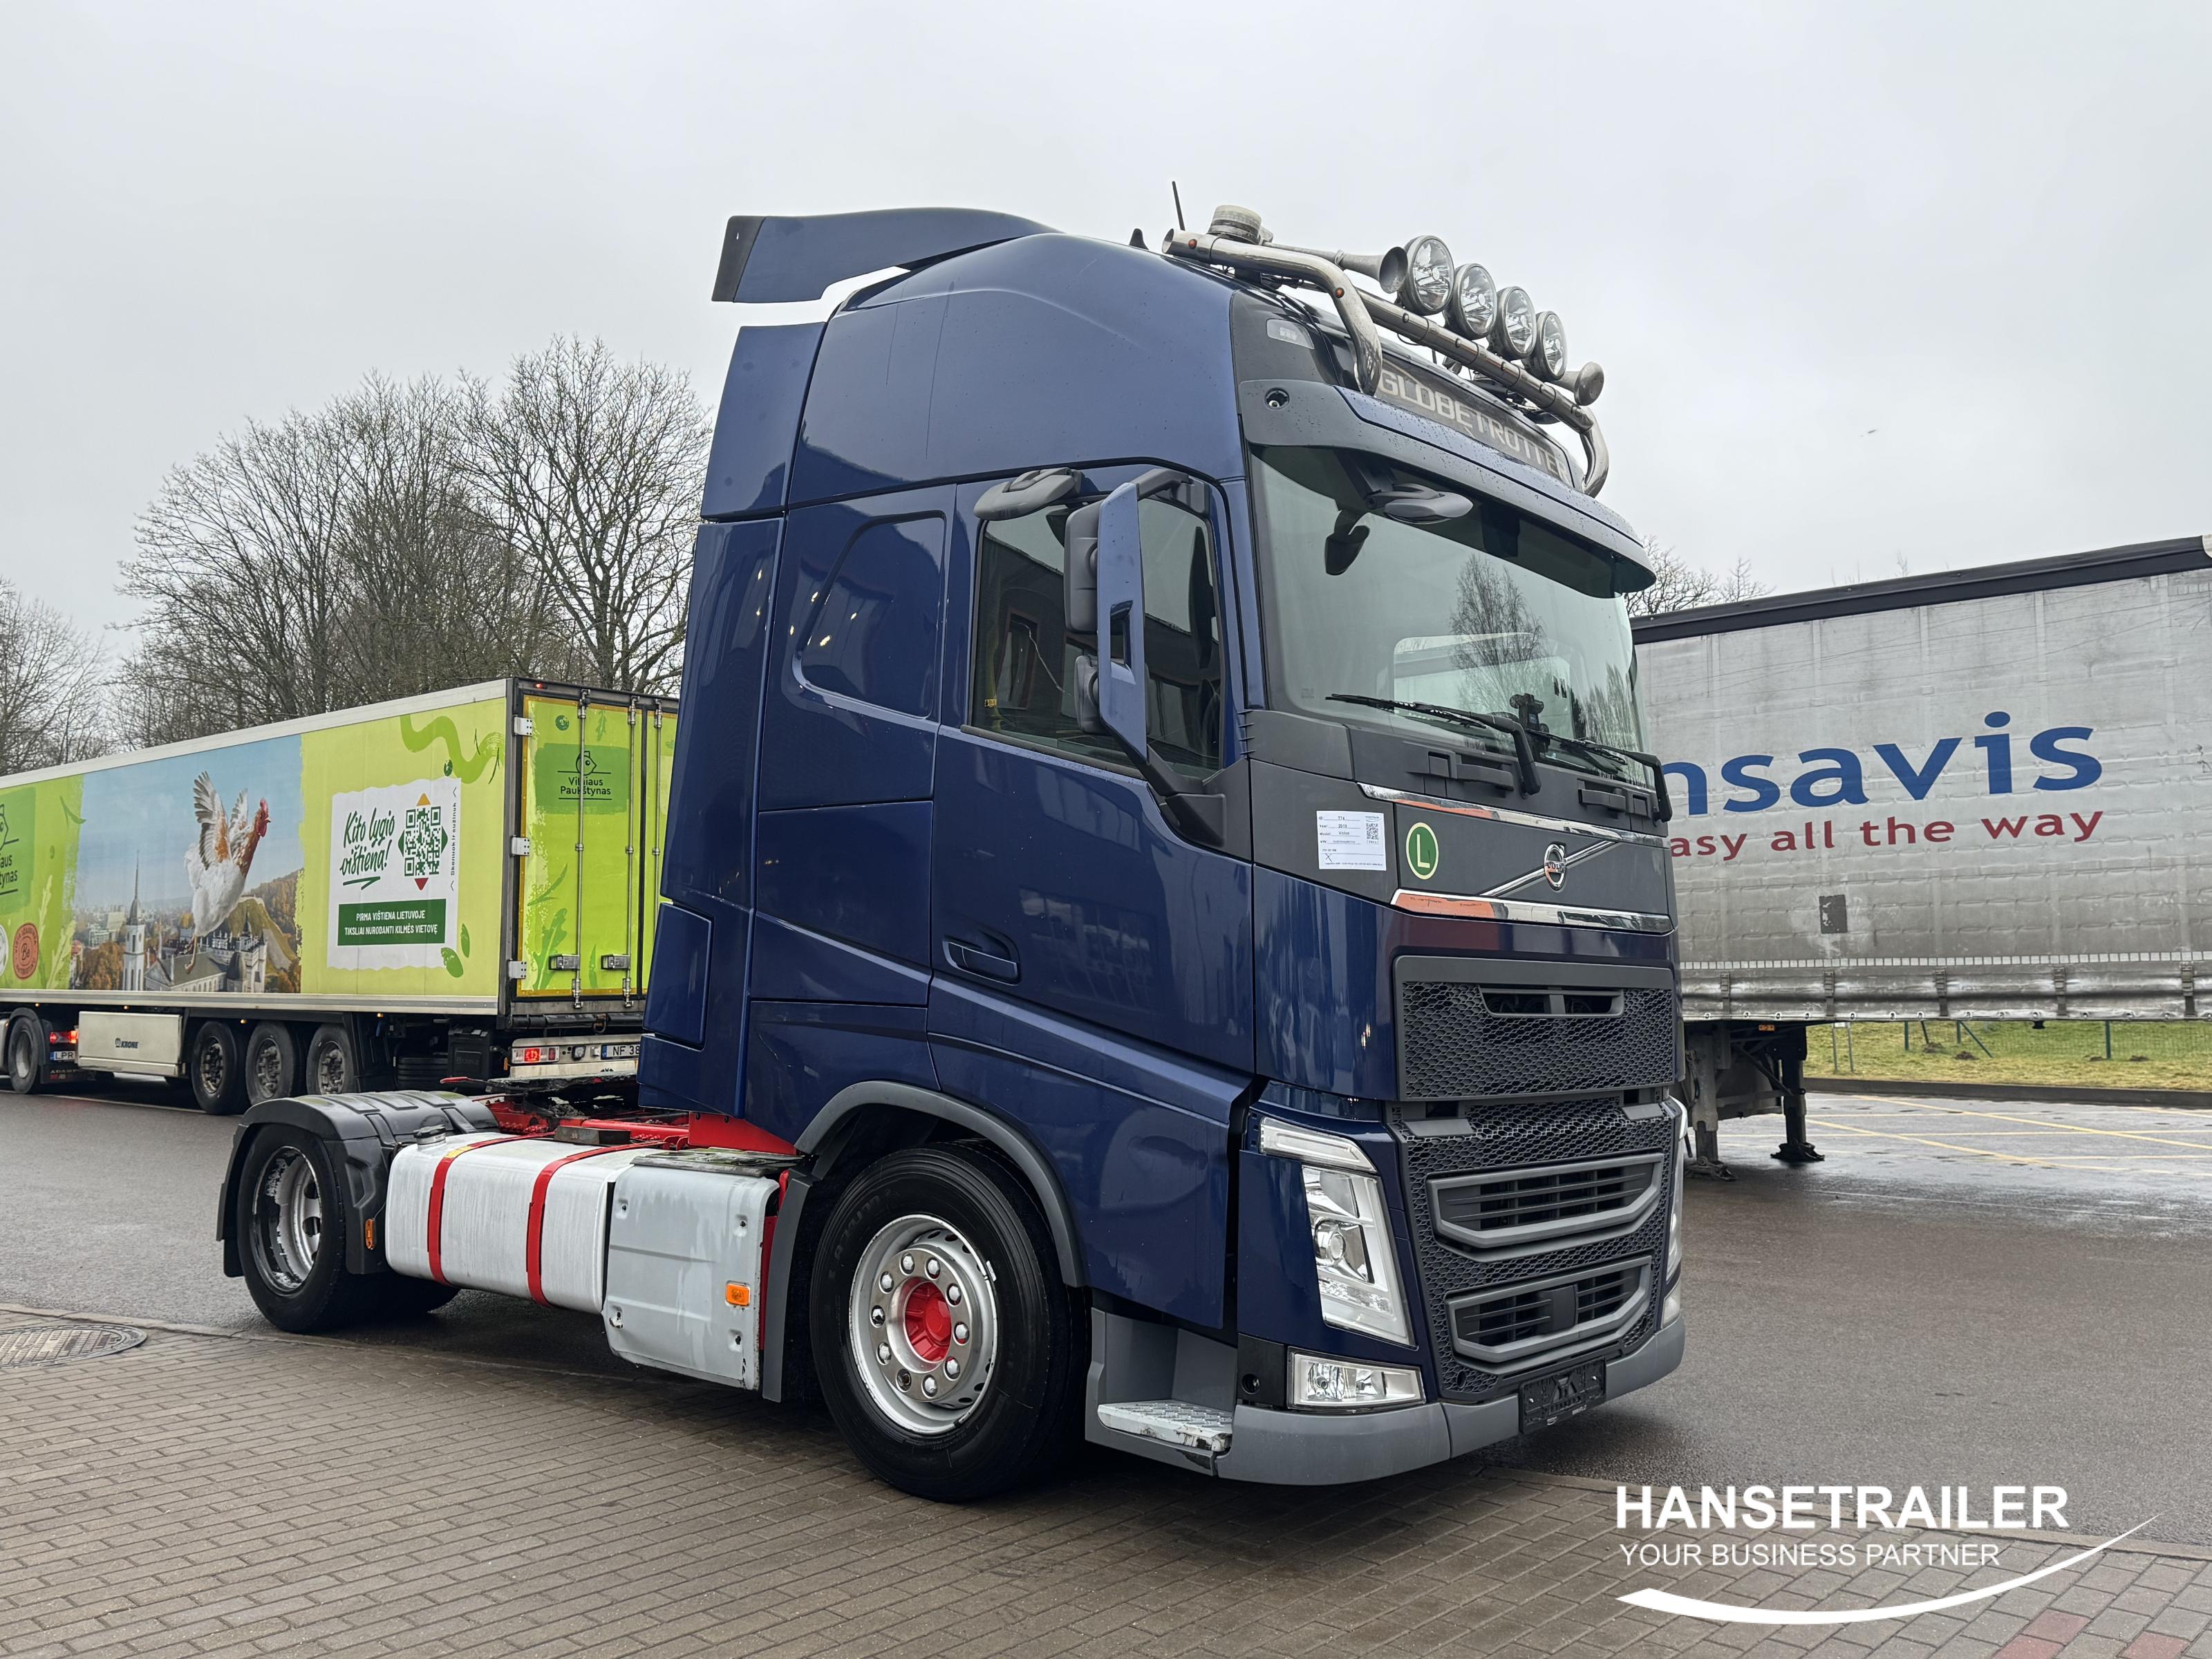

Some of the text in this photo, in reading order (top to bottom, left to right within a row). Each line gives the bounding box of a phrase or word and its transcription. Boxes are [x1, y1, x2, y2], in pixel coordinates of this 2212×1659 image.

[1379, 369, 1569, 482] GLOBETROTTER
[344, 807, 395, 848] Kito lygio
[1770, 821, 1835, 852] all
[1859, 816, 1955, 846] the
[1981, 811, 2103, 843] way
[1416, 834, 1430, 868] L
[0, 852, 12, 868] aus
[356, 910, 426, 921] PIRMA VIŠTIENA LIETUVOJE
[344, 923, 438, 935] TIKSLIAI NURODANTI KILMĖS VIETOVĘ
[55, 1051, 74, 1060] LPR
[612, 1046, 626, 1056] NF
